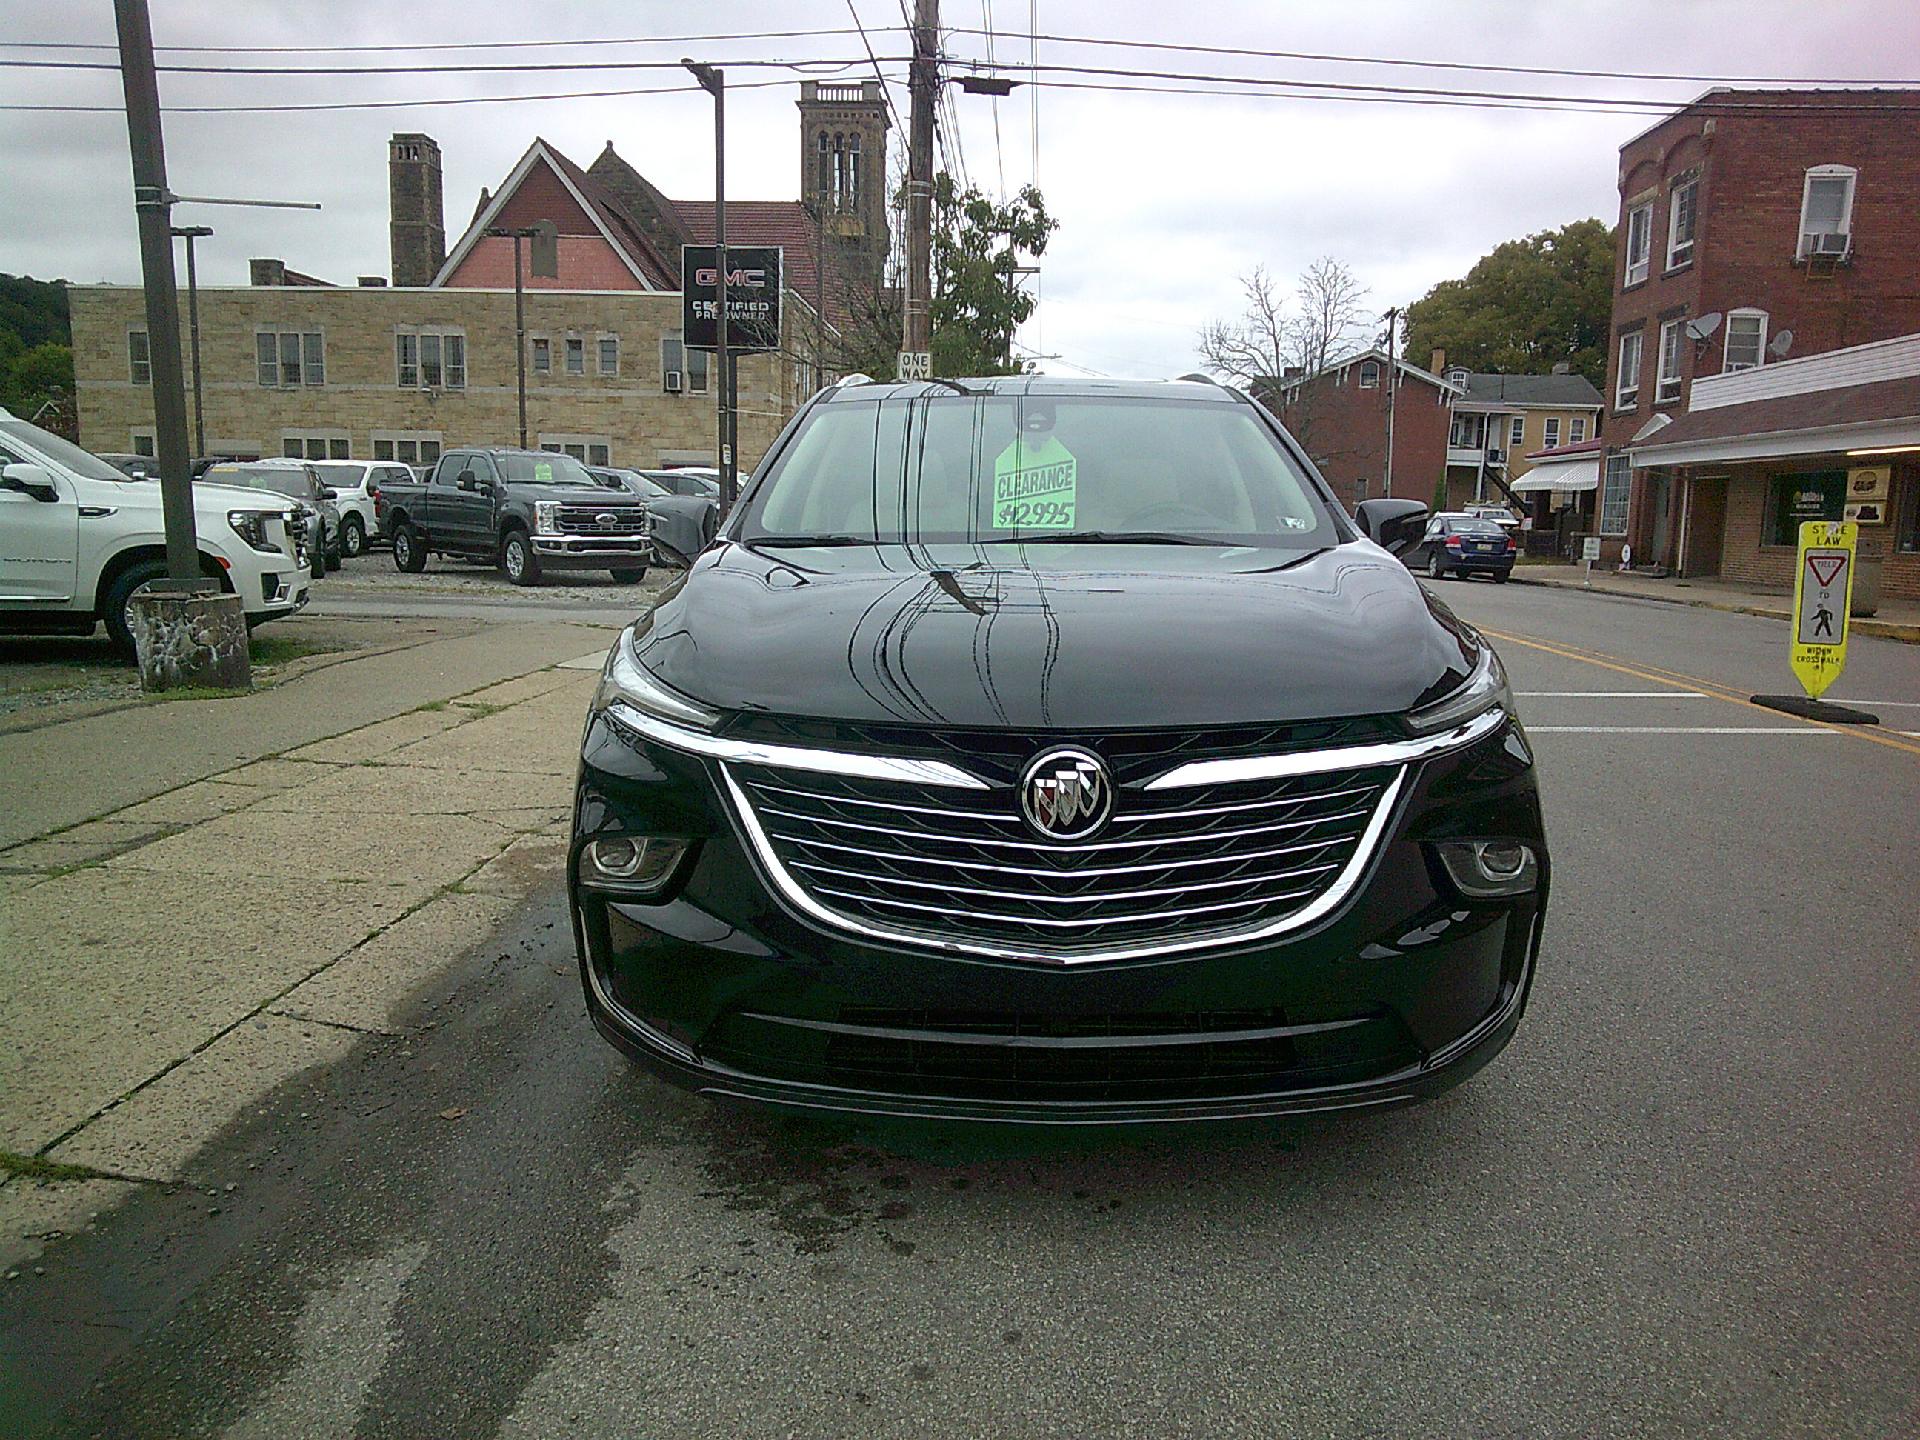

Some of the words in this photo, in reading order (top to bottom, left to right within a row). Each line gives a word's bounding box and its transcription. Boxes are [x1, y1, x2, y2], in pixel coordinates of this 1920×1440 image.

[695, 269, 765, 287] GMC
[692, 301, 769, 311] CETIFIED
[903, 355, 928, 366] ONE
[902, 368, 928, 381] WAY
[998, 464, 1073, 499] CLEARANCE
[1812, 525, 1848, 535] STTE
[1816, 536, 1842, 546] LAW
[1817, 560, 1837, 569] YIELD
